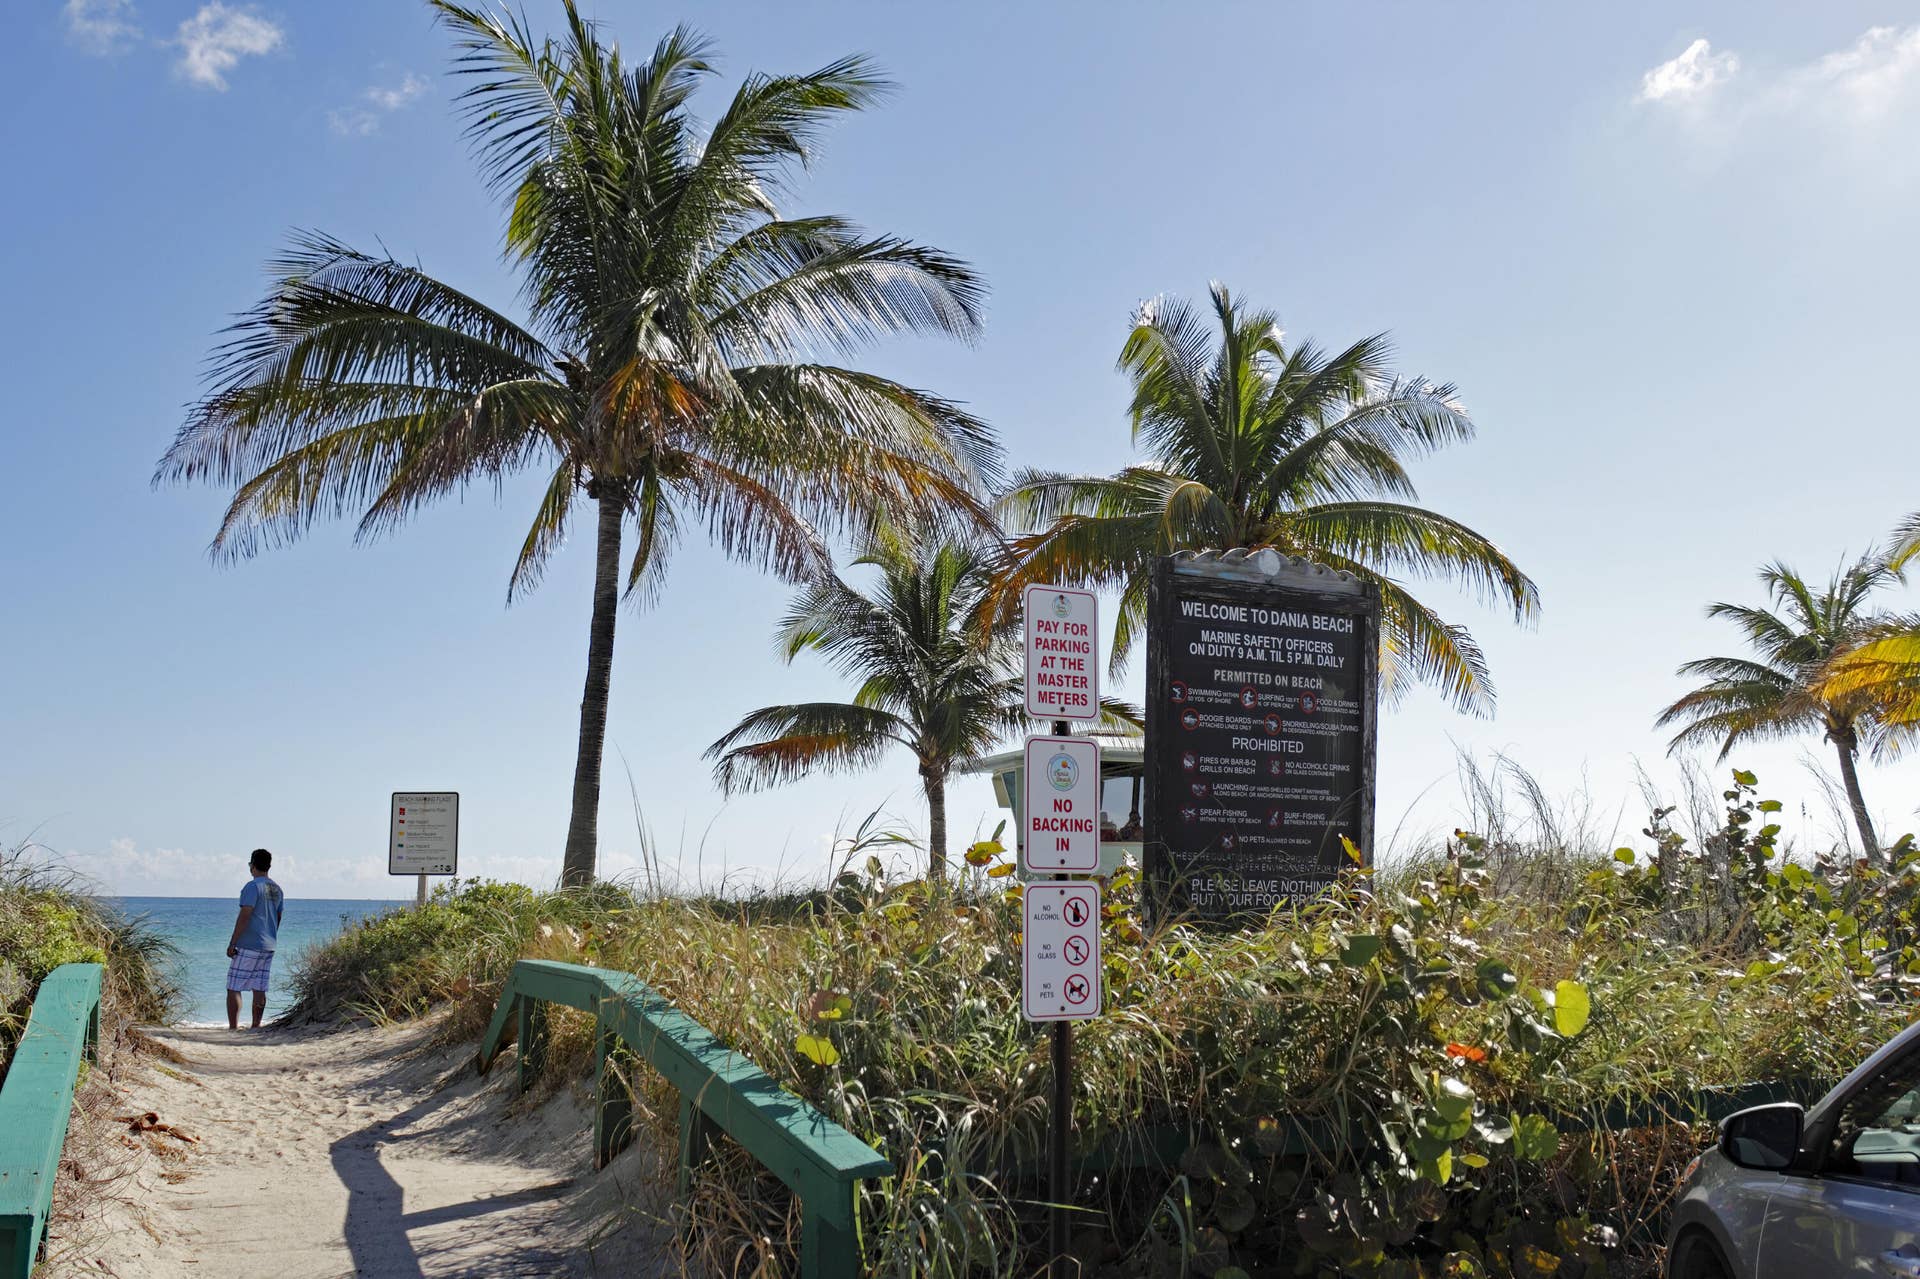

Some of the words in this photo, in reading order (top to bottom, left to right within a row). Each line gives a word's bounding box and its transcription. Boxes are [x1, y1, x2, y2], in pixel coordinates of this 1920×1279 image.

[1181, 601, 1248, 622] WELCOME
[1251, 608, 1267, 624] TO
[1271, 611, 1309, 628] DANIA
[1312, 616, 1353, 633] BEACH
[1037, 620, 1059, 633] PAY
[1064, 622, 1088, 636] FOR
[1035, 637, 1090, 654] PARKING
[1201, 630, 1241, 645] MARINE
[1243, 634, 1282, 650] SAFETY
[1286, 638, 1334, 654] OFFICERS
[1190, 643, 1204, 655] ON
[1208, 644, 1236, 658] DUTY
[1238, 648, 1243, 659] 9
[1246, 648, 1267, 661] A.M.
[1270, 651, 1284, 663] TIL
[1287, 653, 1293, 664] 5
[1295, 653, 1314, 666] P.M.
[1317, 655, 1344, 668] DAILY
[1041, 656, 1056, 669] AT
[1060, 657, 1084, 671] THE
[1037, 673, 1088, 689] MASTER
[1214, 669, 1271, 685] PERMITTED
[1275, 674, 1289, 686] ON
[1292, 676, 1322, 690] BEACH
[1038, 691, 1088, 706] METERS
[1188, 688, 1222, 697] SWIMMING
[1258, 693, 1285, 702] SURFING
[1199, 714, 1224, 722] BOOGIE
[1225, 716, 1252, 724] BOARDS
[1232, 737, 1303, 753] PROHIBITED
[1053, 799, 1072, 812] NO
[1033, 818, 1093, 832] BACKING
[1056, 838, 1070, 851] IN
[1242, 880, 1278, 892] LEAVE
[1191, 894, 1215, 906] BUT
